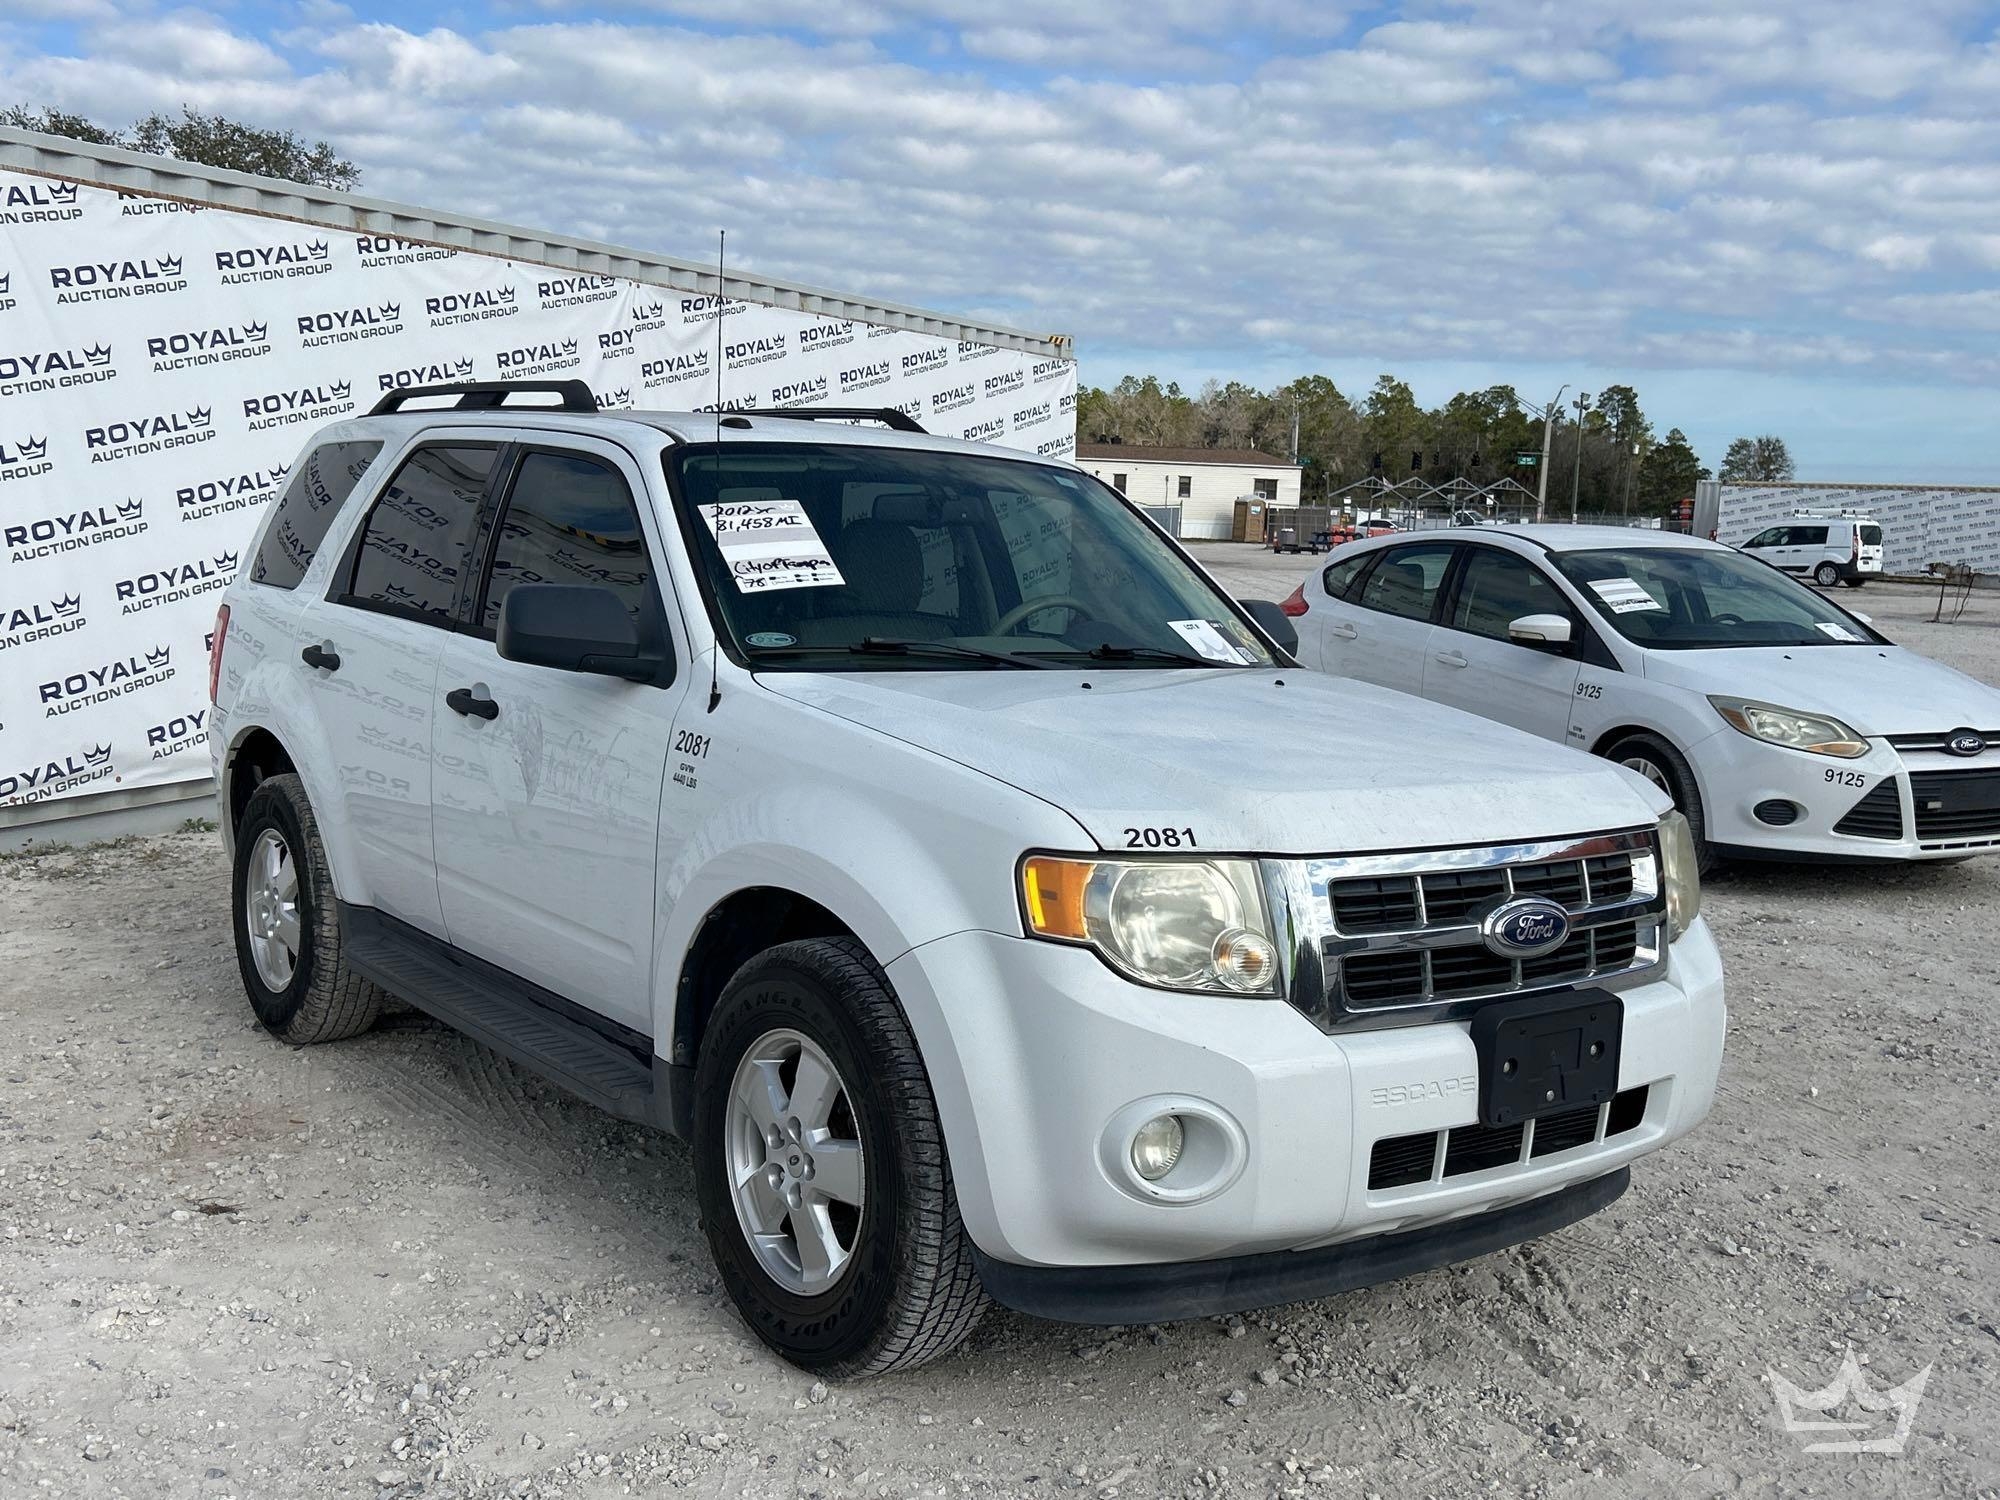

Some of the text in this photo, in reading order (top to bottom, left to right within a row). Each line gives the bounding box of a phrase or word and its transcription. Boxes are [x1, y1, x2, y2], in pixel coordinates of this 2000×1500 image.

[22, 208, 83, 223] GROUP
[216, 245, 308, 270] ROYAL
[361, 250, 457, 268] AUCTION GROUP
[51, 260, 158, 288] ROYAL
[221, 263, 332, 285] AUCTION GROUP
[57, 280, 187, 304] AUCTION GROUP
[538, 276, 600, 298] ROYAL
[426, 290, 498, 314] ROYAL
[541, 290, 618, 310] AUCTION GROUP
[298, 307, 380, 334] ROYAL
[430, 306, 518, 327] AUCTION GROUP
[683, 305, 746, 324] AUCTION GROUP
[302, 324, 403, 348] AUCTION GROUP
[635, 320, 666, 333] GROUP
[800, 324, 843, 343] ROYAL
[147, 327, 244, 357] ROYAL
[725, 338, 774, 360] ROYAL
[802, 335, 854, 353] AUCTION GROUP
[153, 345, 271, 372] AUCTION GROUP
[497, 343, 562, 368] ROYAL
[641, 354, 695, 377] ROYAL
[727, 350, 787, 370] AUCTION GROUP
[902, 350, 938, 368] ROYAL
[959, 352, 981, 362] AUCTION
[378, 363, 455, 391] ROYAL
[500, 357, 580, 380] AUCTION GROUP
[644, 367, 710, 389] AUCTION GROUP
[840, 364, 880, 384] ROYAL
[903, 359, 948, 377] AUCTION GROUP
[1032, 359, 1062, 376] ROYAL
[1033, 368, 1070, 384] AUCTION GROUP
[59, 369, 117, 388] GROUP
[842, 375, 891, 394] AUCTION GROUP
[984, 373, 1016, 390] ROYAL
[772, 380, 815, 402] ROYAL
[804, 392, 829, 404] GROUP
[932, 388, 966, 407] ROYAL
[986, 382, 1024, 398] AUCTION GROUP
[243, 386, 331, 417] ROYAL
[934, 396, 975, 415] AUCTION GROUP
[248, 402, 355, 431] AUCTION GROUP
[1013, 406, 1043, 423] ROYAL
[1014, 414, 1051, 431] AUCTION GROUP
[86, 414, 188, 448] ROYAL
[963, 421, 996, 440] ROYAL
[91, 430, 216, 463] AUCTION GROUP
[1037, 437, 1066, 455] ROYAL
[0, 462, 53, 481] ROUP
[176, 472, 270, 507] ROYAL
[182, 490, 277, 522] AUCTION GRO
[710, 505, 754, 518] 2012
[4, 508, 117, 547] ROYAL
[716, 517, 773, 532] 81,458
[11, 522, 148, 563] AUCTION GROUP
[115, 560, 215, 601] ROYAL
[121, 587, 190, 615] AUCTION
[25, 618, 87, 642] GROUP
[39, 657, 147, 703] ROYAL
[45, 667, 176, 718] AUCTION GROUP
[1576, 682, 1602, 700] 9125
[147, 710, 206, 747] ROY
[674, 730, 711, 759] 2081
[1960, 738, 1979, 749] Ford
[55, 765, 114, 793] GROUP
[679, 763, 695, 774] GVW
[1824, 769, 1865, 788] 9125
[686, 777, 698, 789] LBS
[1123, 827, 1197, 848] 2081
[1516, 914, 1554, 941] Ford
[1371, 1075, 1476, 1109] ESCAPE
